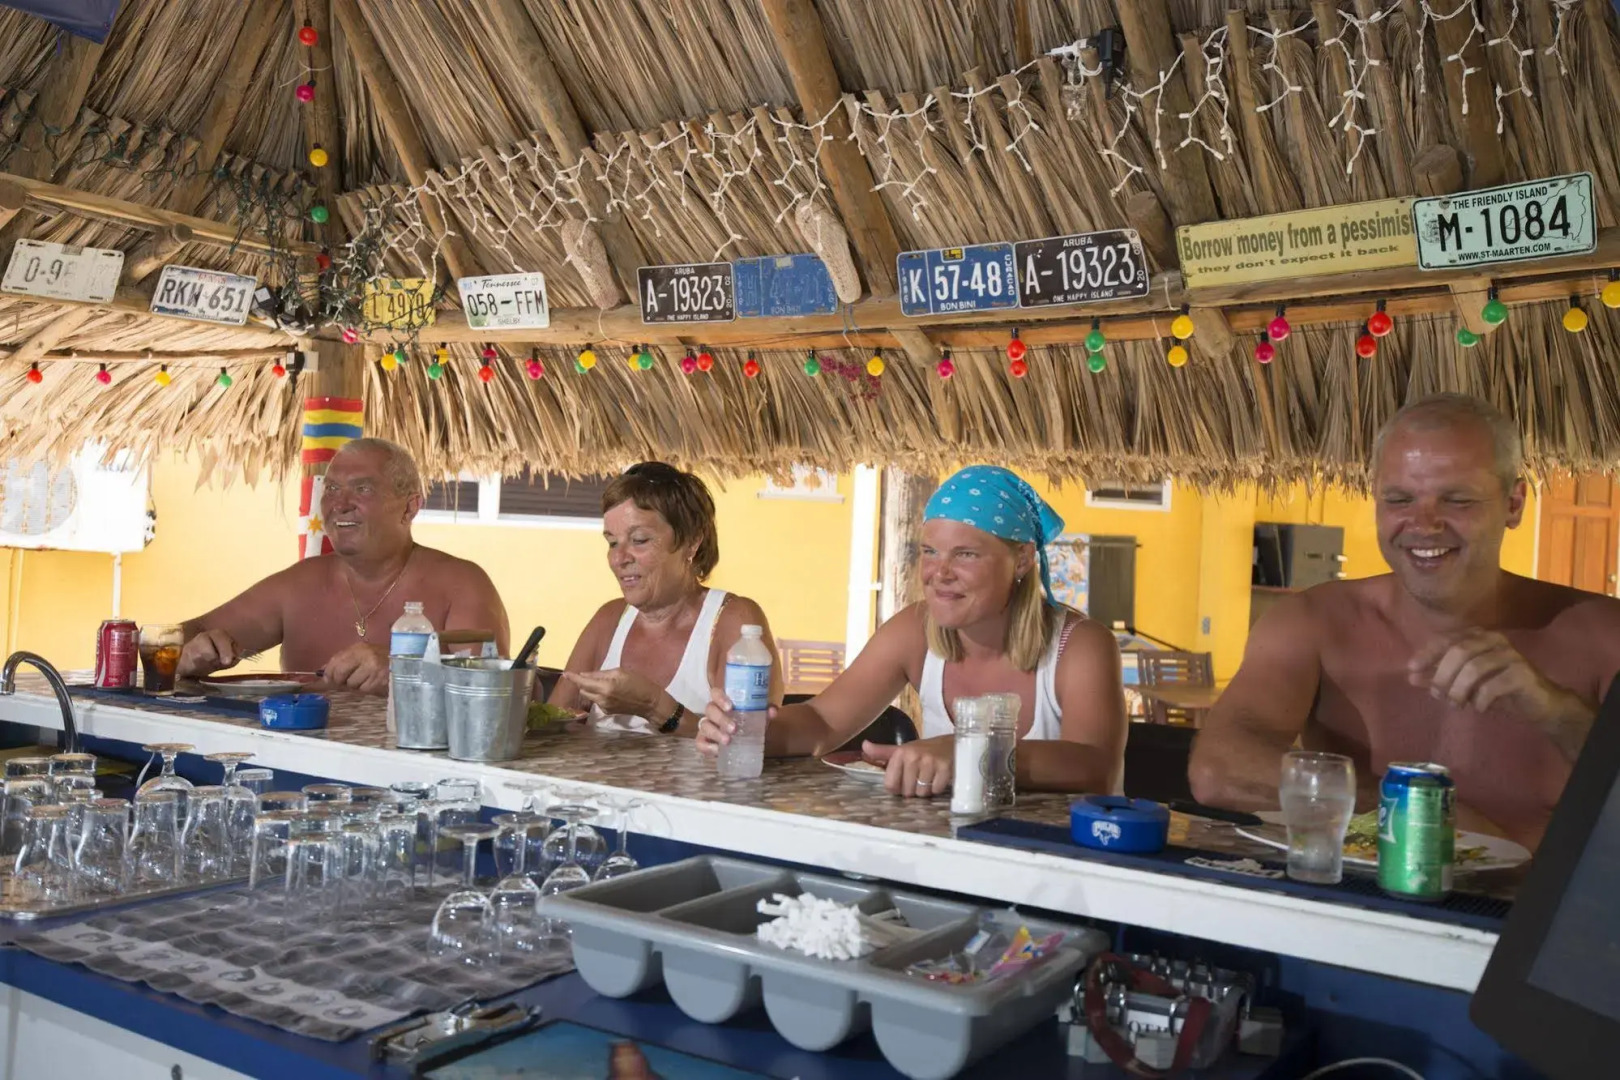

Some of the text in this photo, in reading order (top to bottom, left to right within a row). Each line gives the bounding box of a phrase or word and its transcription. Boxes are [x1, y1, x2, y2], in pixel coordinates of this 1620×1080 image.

[1453, 186, 1548, 210] THE FRIENDLY ISLAND
[1437, 195, 1571, 252] M-1084
[1063, 237, 1093, 248] ARUBA
[1182, 235, 1233, 261] Borrow
[1236, 229, 1284, 256] money
[1287, 222, 1323, 249] from
[1326, 222, 1337, 245] a
[1458, 243, 1551, 261] WWW.ST-MAARTEN.COM
[674, 267, 696, 275] ARUBA
[1025, 243, 1135, 295] A-19323
[1197, 244, 1399, 274] they don't expect it back
[482, 278, 521, 290] Tennessee
[646, 275, 726, 313] A-19323
[909, 260, 1003, 304] K 57-48
[467, 289, 545, 317] 058-FFM
[940, 300, 976, 311] BON BINI
[1053, 289, 1114, 303] ONE HAPPY ISLAND
